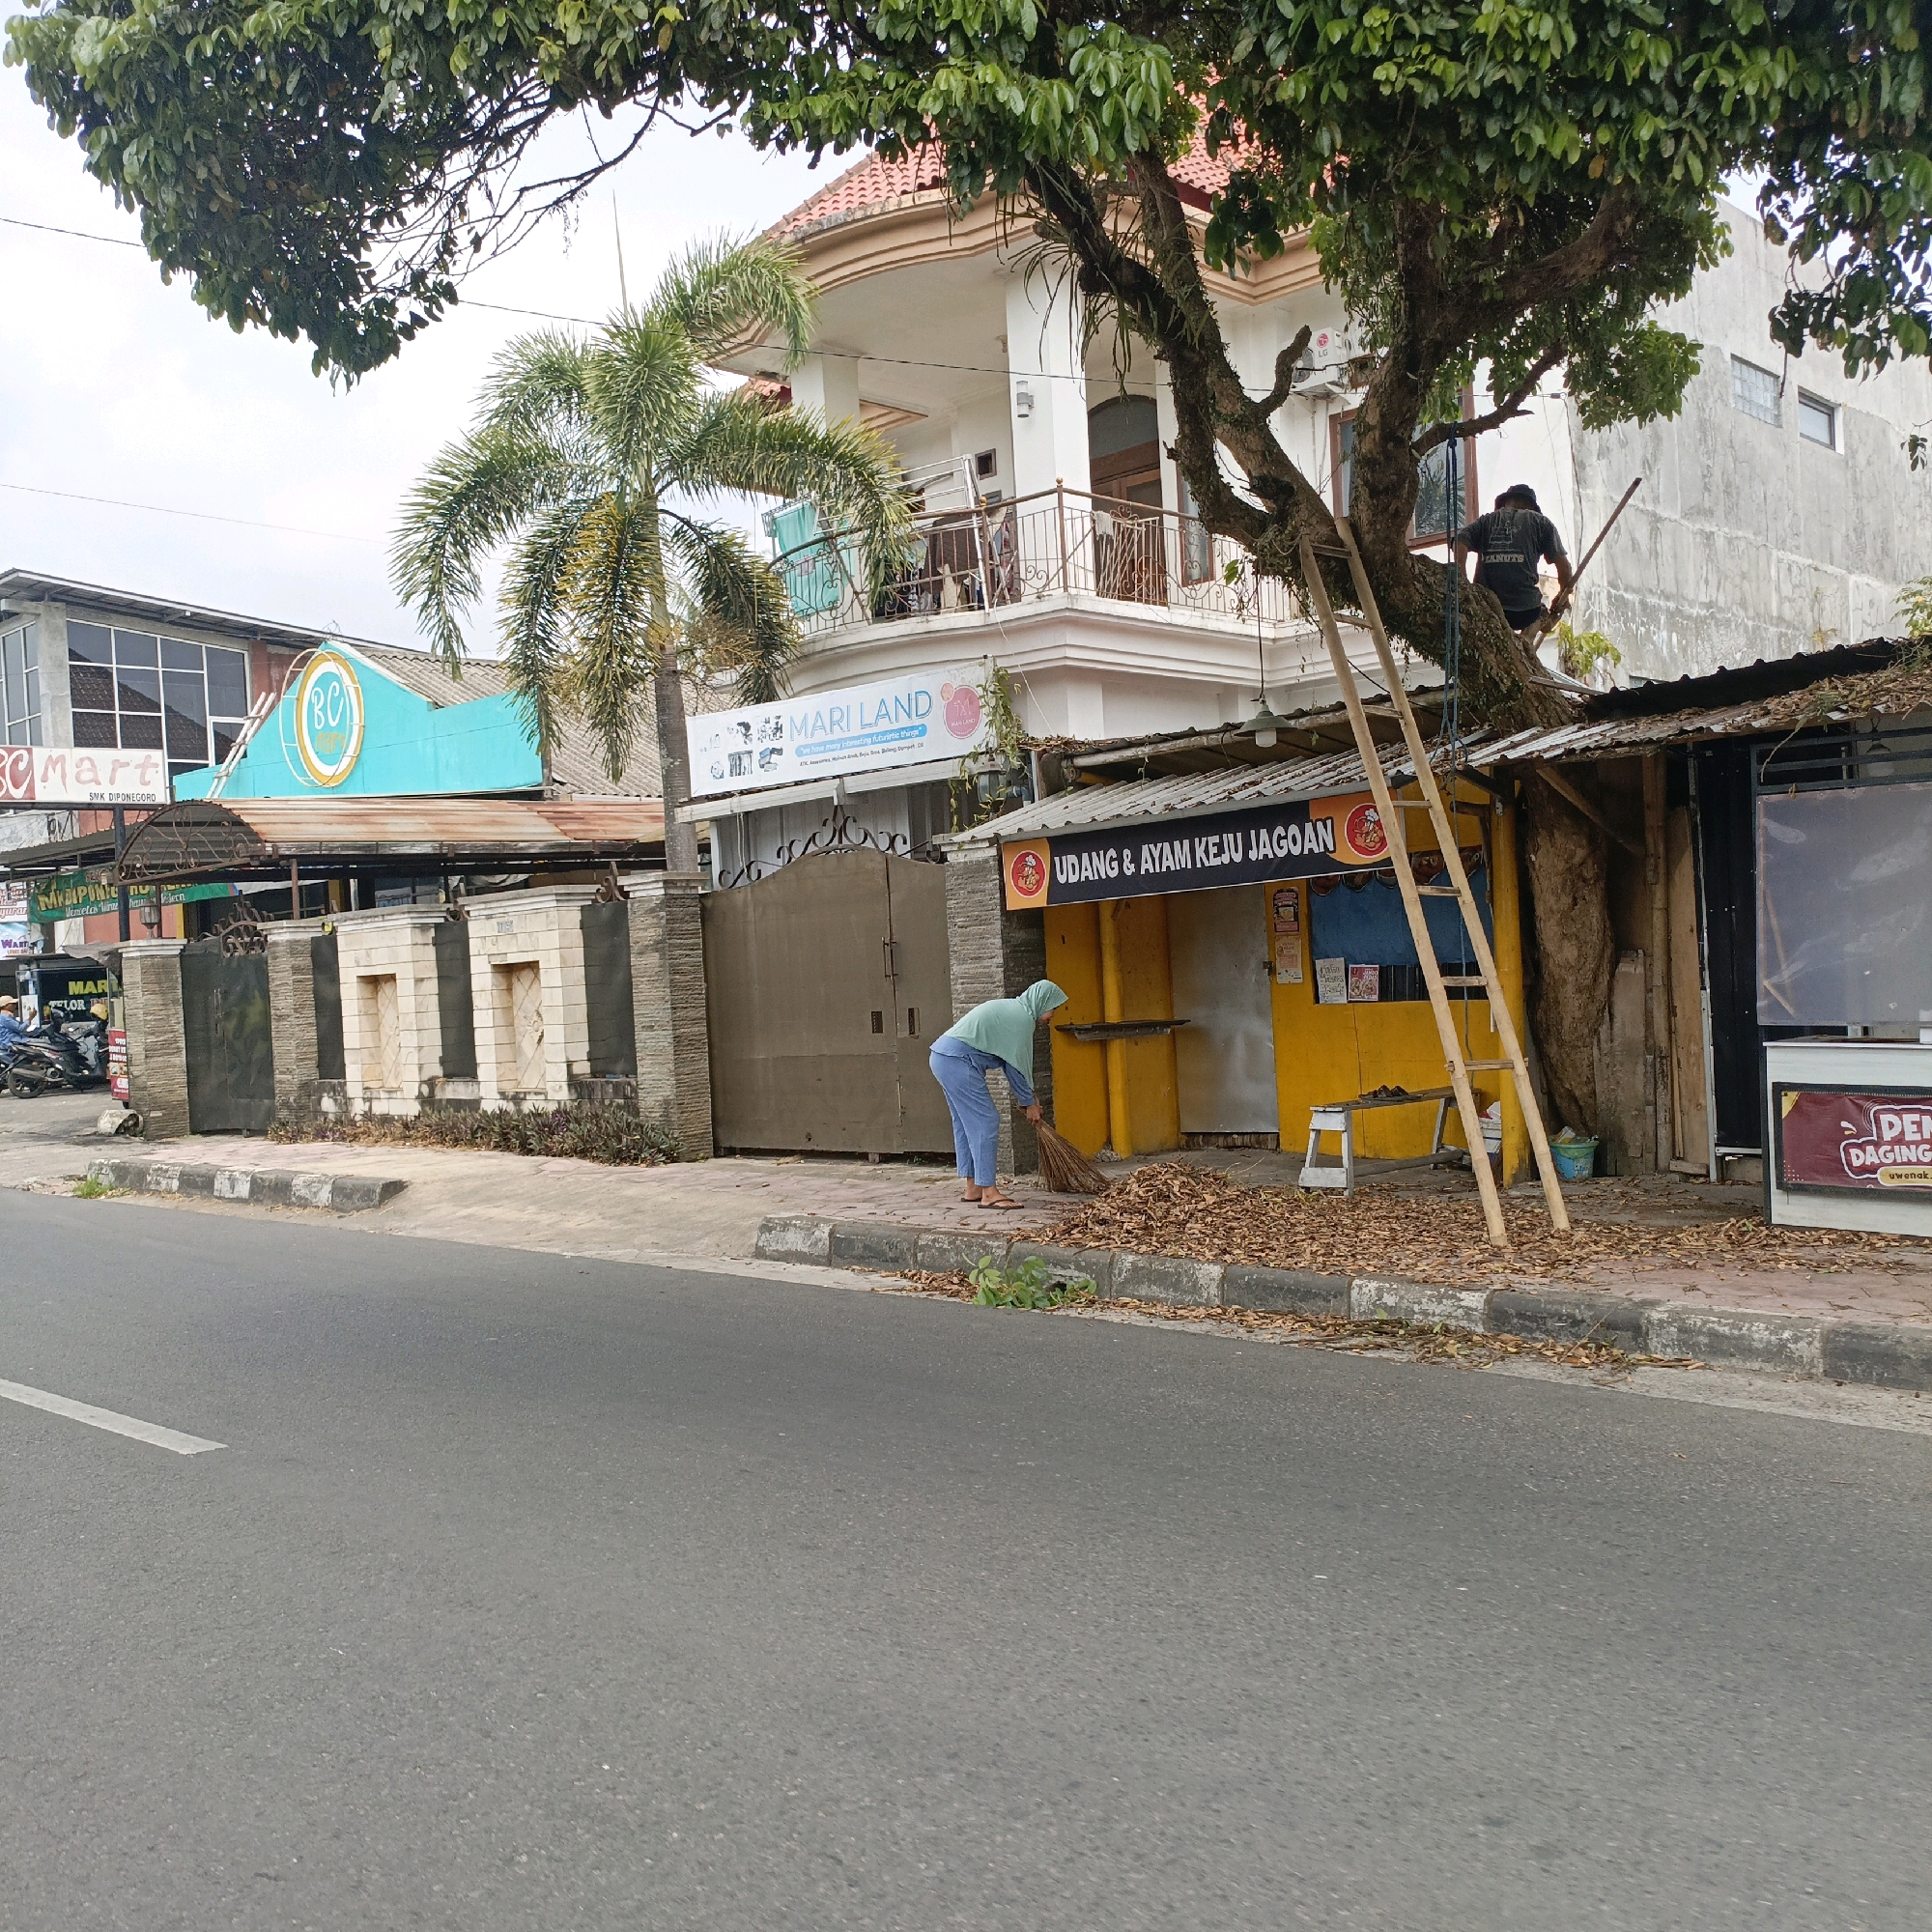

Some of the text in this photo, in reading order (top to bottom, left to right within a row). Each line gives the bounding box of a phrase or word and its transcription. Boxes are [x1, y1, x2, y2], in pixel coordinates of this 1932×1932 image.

[1318, 349, 1328, 357] LG
[311, 681, 344, 730] BC
[789, 690, 933, 741] MARI LAND
[41, 753, 159, 794] Mart
[89, 792, 156, 802] SMK DIPONEGORO
[1053, 818, 1335, 884] UDANG & AYAM KEJU JAGOAN
[1849, 1144, 1932, 1167] DAGING
